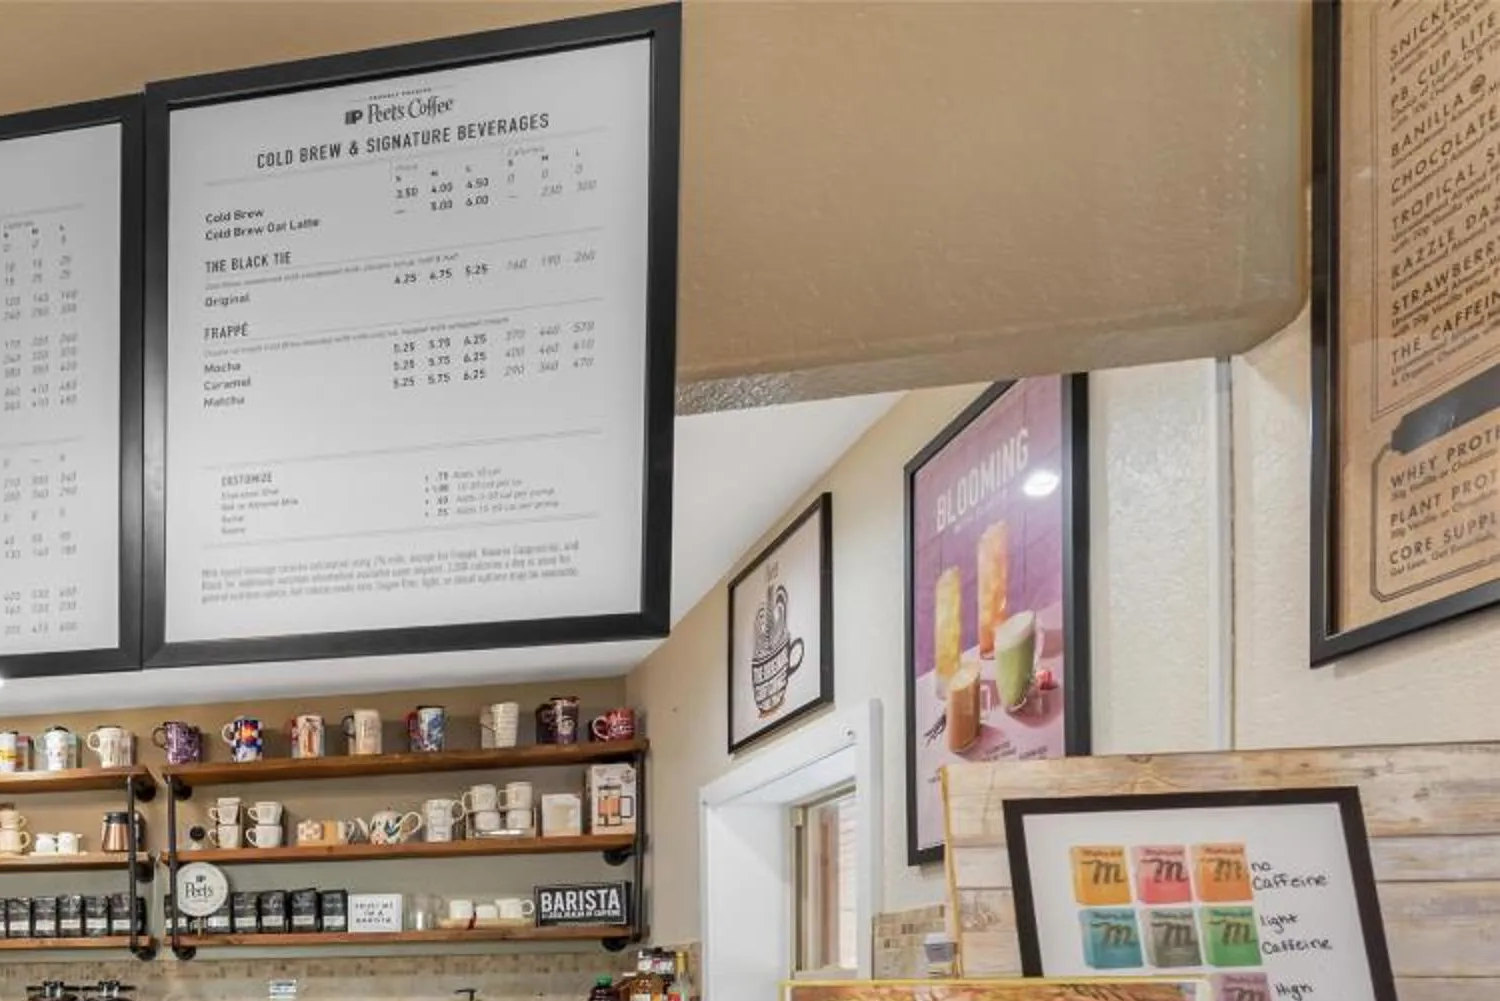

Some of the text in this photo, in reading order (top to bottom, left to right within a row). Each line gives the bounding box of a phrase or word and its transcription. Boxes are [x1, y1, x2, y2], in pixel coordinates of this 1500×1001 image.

[1461, 10, 1495, 51] LITE
[408, 96, 454, 119] Coffee
[257, 112, 550, 169] COLD BREW & SIGNATURE BEVERAGES
[1391, 104, 1498, 194] CHOCOLATE
[1392, 163, 1476, 230] TROPICAL
[205, 208, 265, 224] Cold Brew
[205, 218, 320, 241] Cold Brew Oat Latte
[205, 251, 292, 273] THE BLACK TIE
[1392, 241, 1495, 316] STRAWBERR
[205, 293, 251, 308] Original
[1392, 338, 1421, 363] THE
[204, 361, 241, 374] Mocha
[203, 377, 251, 391] Caramel
[203, 395, 245, 408] Matcha
[937, 428, 1029, 533] BLOOMING
[1390, 455, 1438, 488] WHEY
[1391, 493, 1441, 527] PLANT
[1390, 512, 1497, 564] CORE SUPPL
[1251, 862, 1271, 872] no
[1253, 873, 1329, 890] Caffeine
[541, 887, 620, 912] BARISTA
